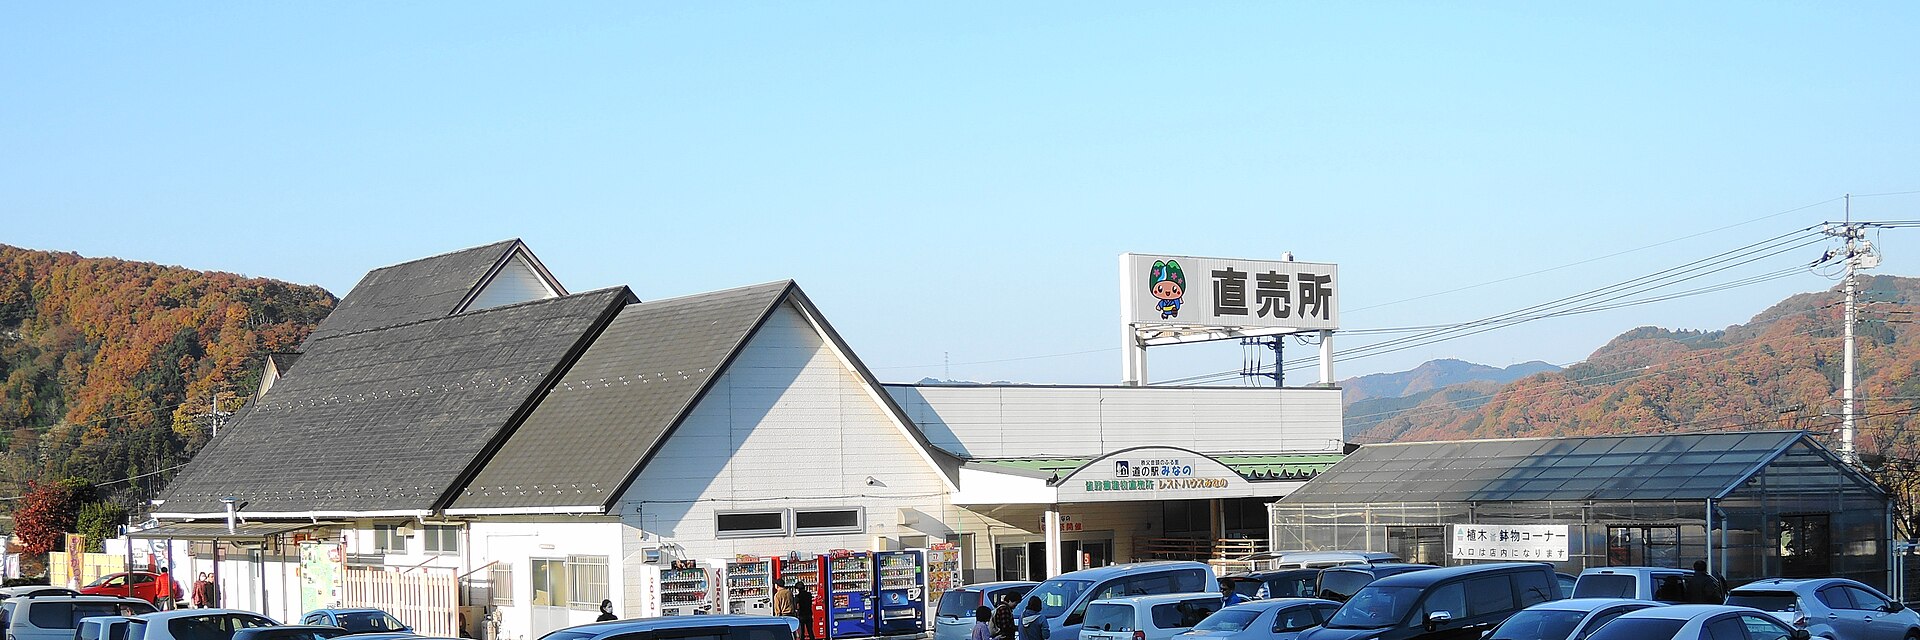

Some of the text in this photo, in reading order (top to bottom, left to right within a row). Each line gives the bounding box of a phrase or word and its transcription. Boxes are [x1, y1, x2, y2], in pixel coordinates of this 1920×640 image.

[1211, 266, 1332, 320] 直売所
[1467, 528, 1566, 542] 植木 鉢物コーナー
[1457, 547, 1565, 558] 入口は店内になります
